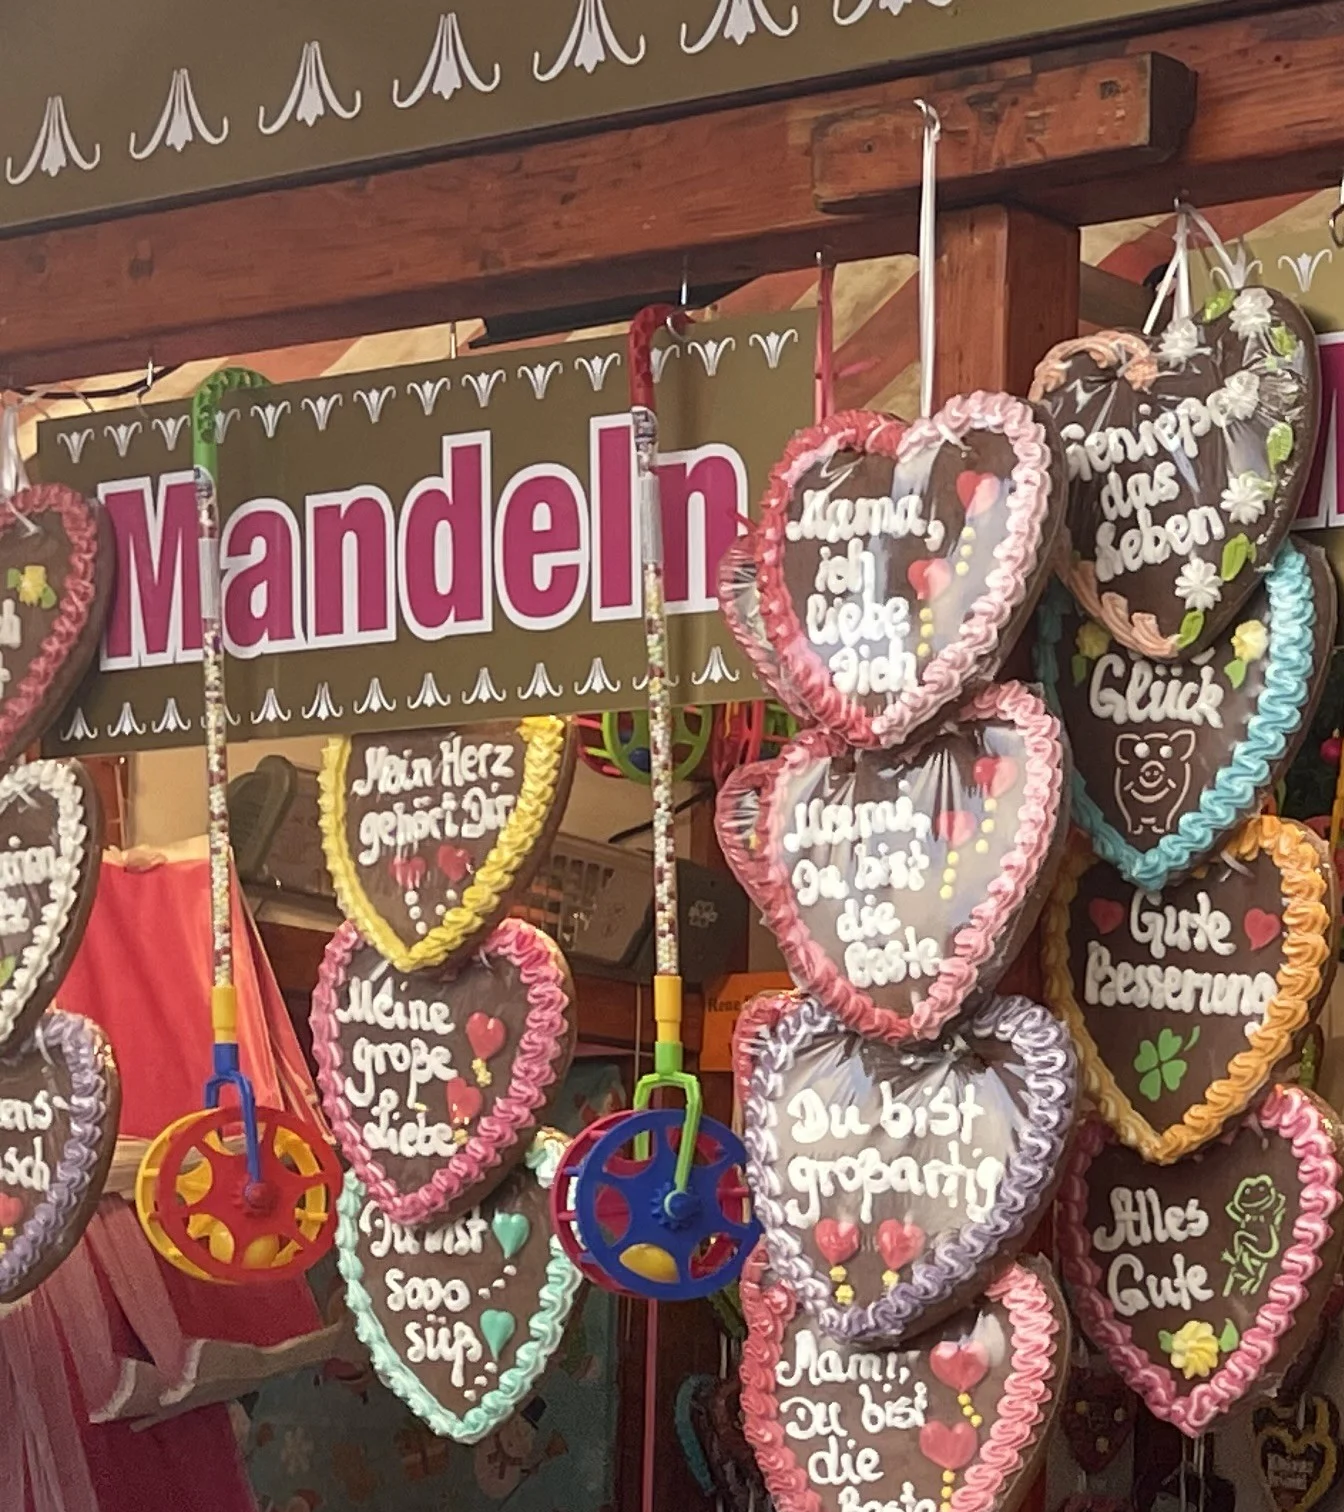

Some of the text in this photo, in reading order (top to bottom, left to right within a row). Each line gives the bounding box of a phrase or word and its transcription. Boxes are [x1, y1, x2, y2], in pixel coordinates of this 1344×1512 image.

[1101, 461, 1180, 521] das
[99, 412, 748, 671] Mandeln
[816, 539, 875, 594] ich
[1095, 506, 1225, 582] Leben
[1090, 654, 1224, 728] Glück
[439, 735, 515, 787] Herz
[358, 791, 460, 866] gehört
[855, 840, 930, 890] bist
[837, 894, 901, 942] die
[1130, 890, 1236, 959] Gute
[336, 973, 456, 1036] Meine
[1085, 941, 1279, 1038] Besserung
[345, 1038, 458, 1111] große
[363, 1089, 459, 1158] Liebe
[787, 1081, 985, 1144] Du bist
[786, 1141, 1004, 1228] großartig
[1093, 1187, 1210, 1251] Alles
[1107, 1253, 1215, 1316] Gute
[405, 1313, 482, 1388] süß
[781, 1381, 929, 1440] Du bist
[808, 1434, 884, 1485] die
